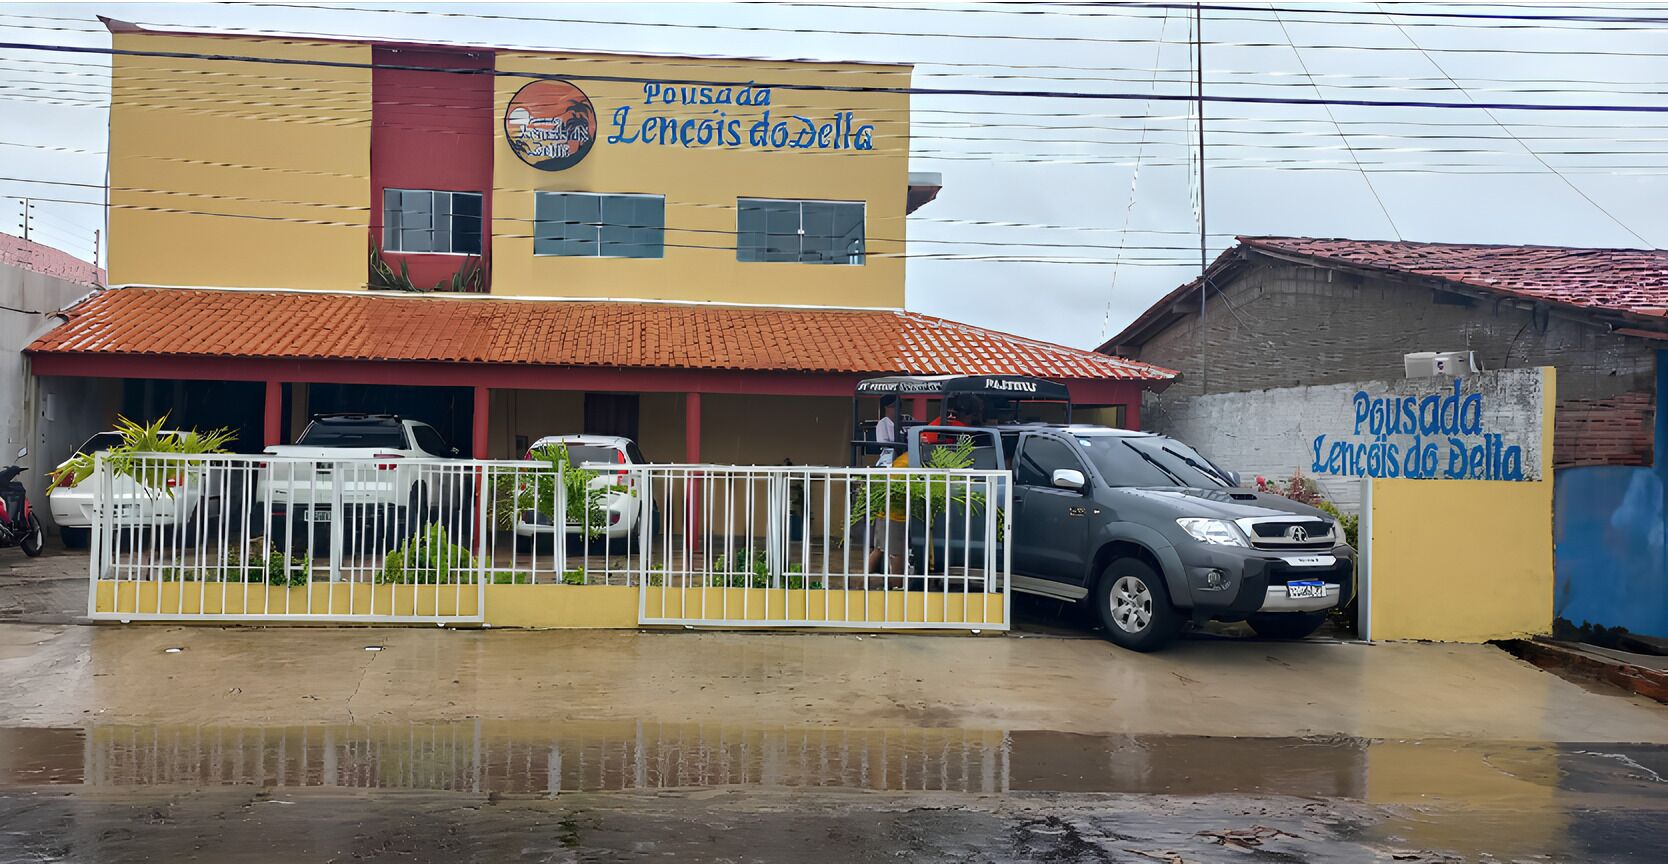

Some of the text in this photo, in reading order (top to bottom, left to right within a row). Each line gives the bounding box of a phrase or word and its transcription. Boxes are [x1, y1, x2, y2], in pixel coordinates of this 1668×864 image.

[643, 80, 771, 106] Pousada
[749, 110, 788, 148] do
[1353, 377, 1483, 436] Pousada
[1403, 434, 1439, 478] do
